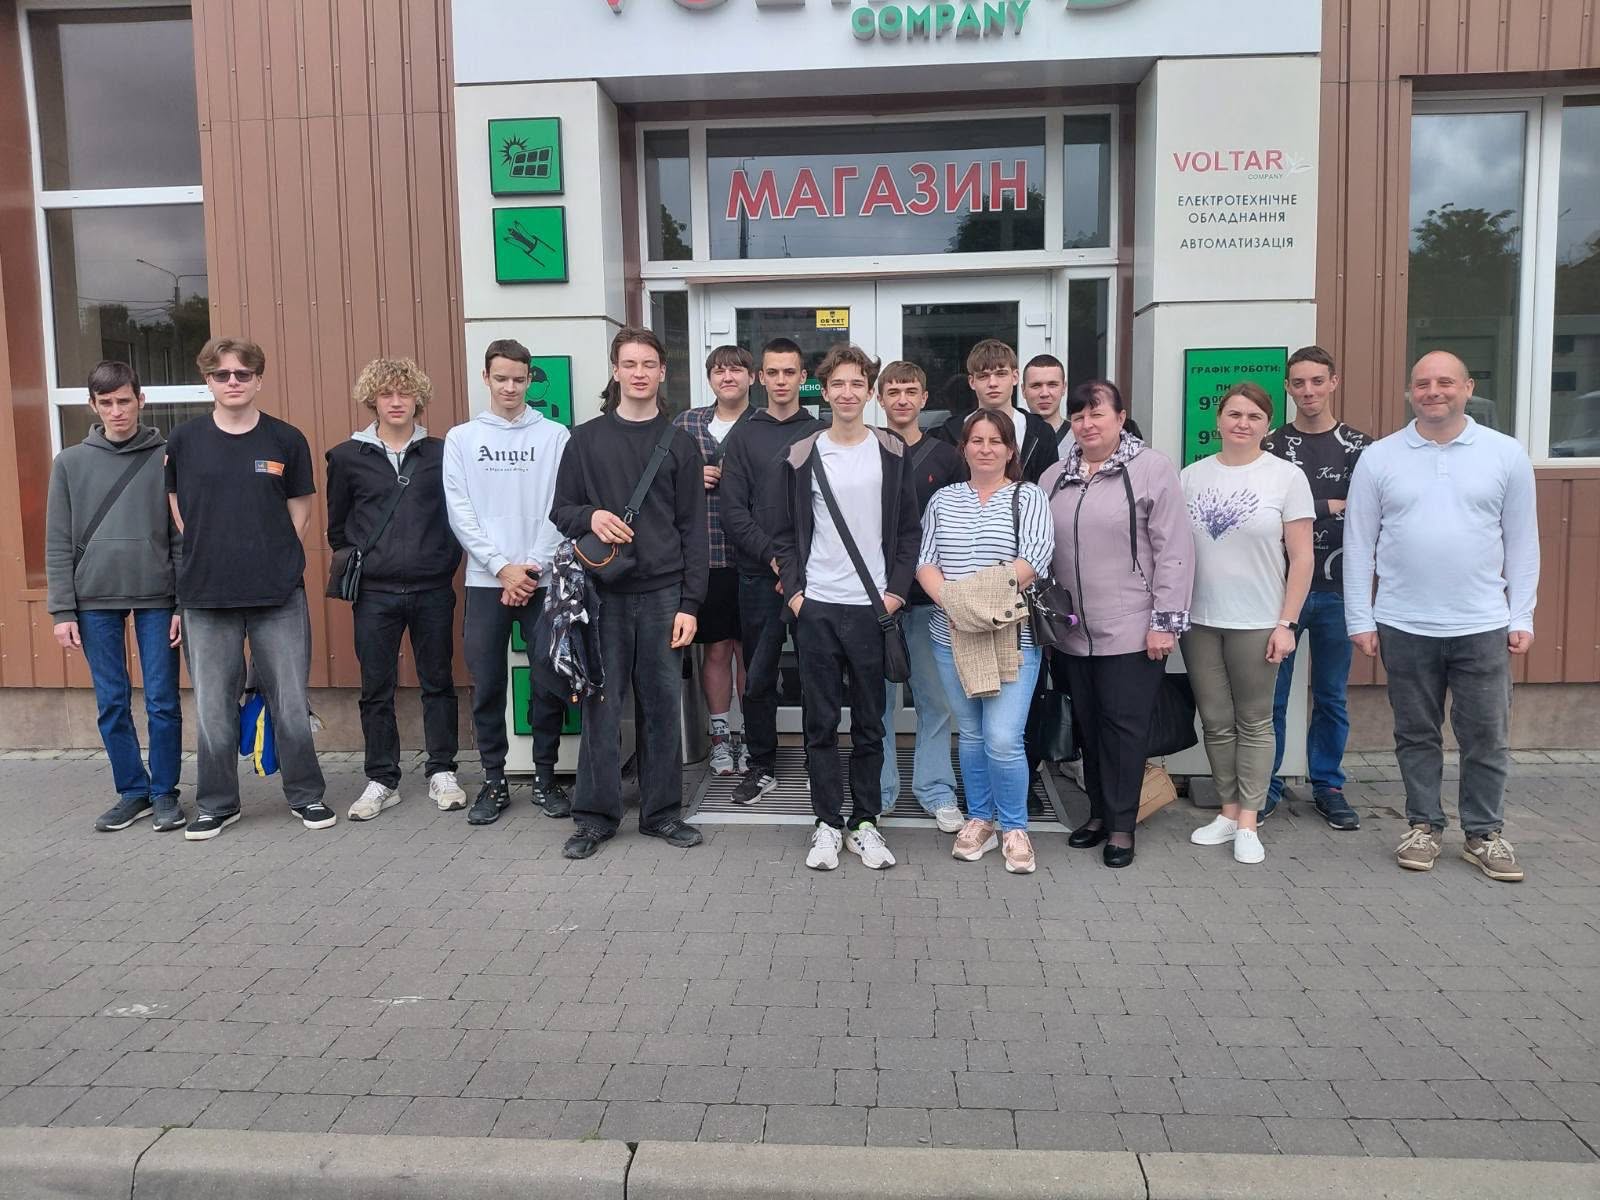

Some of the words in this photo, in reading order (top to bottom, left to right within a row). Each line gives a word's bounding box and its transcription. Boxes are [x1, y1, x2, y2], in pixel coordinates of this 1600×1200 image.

[851, 0, 1031, 40] COMPANY
[1173, 150, 1284, 172] VOLTAR
[725, 159, 1028, 220] МАГАЗИН
[1178, 194, 1297, 206] ЕЛЕКТРОТЕХНІЧНЕ
[1188, 212, 1286, 224] ОБЛАДНАННЯ
[1180, 237, 1294, 249] АВТОМАТИЗАЦІЯ
[1191, 366, 1231, 374] ГРАФІК
[1233, 365, 1281, 373] РОБОТИ:
[477, 445, 536, 465] Angel
